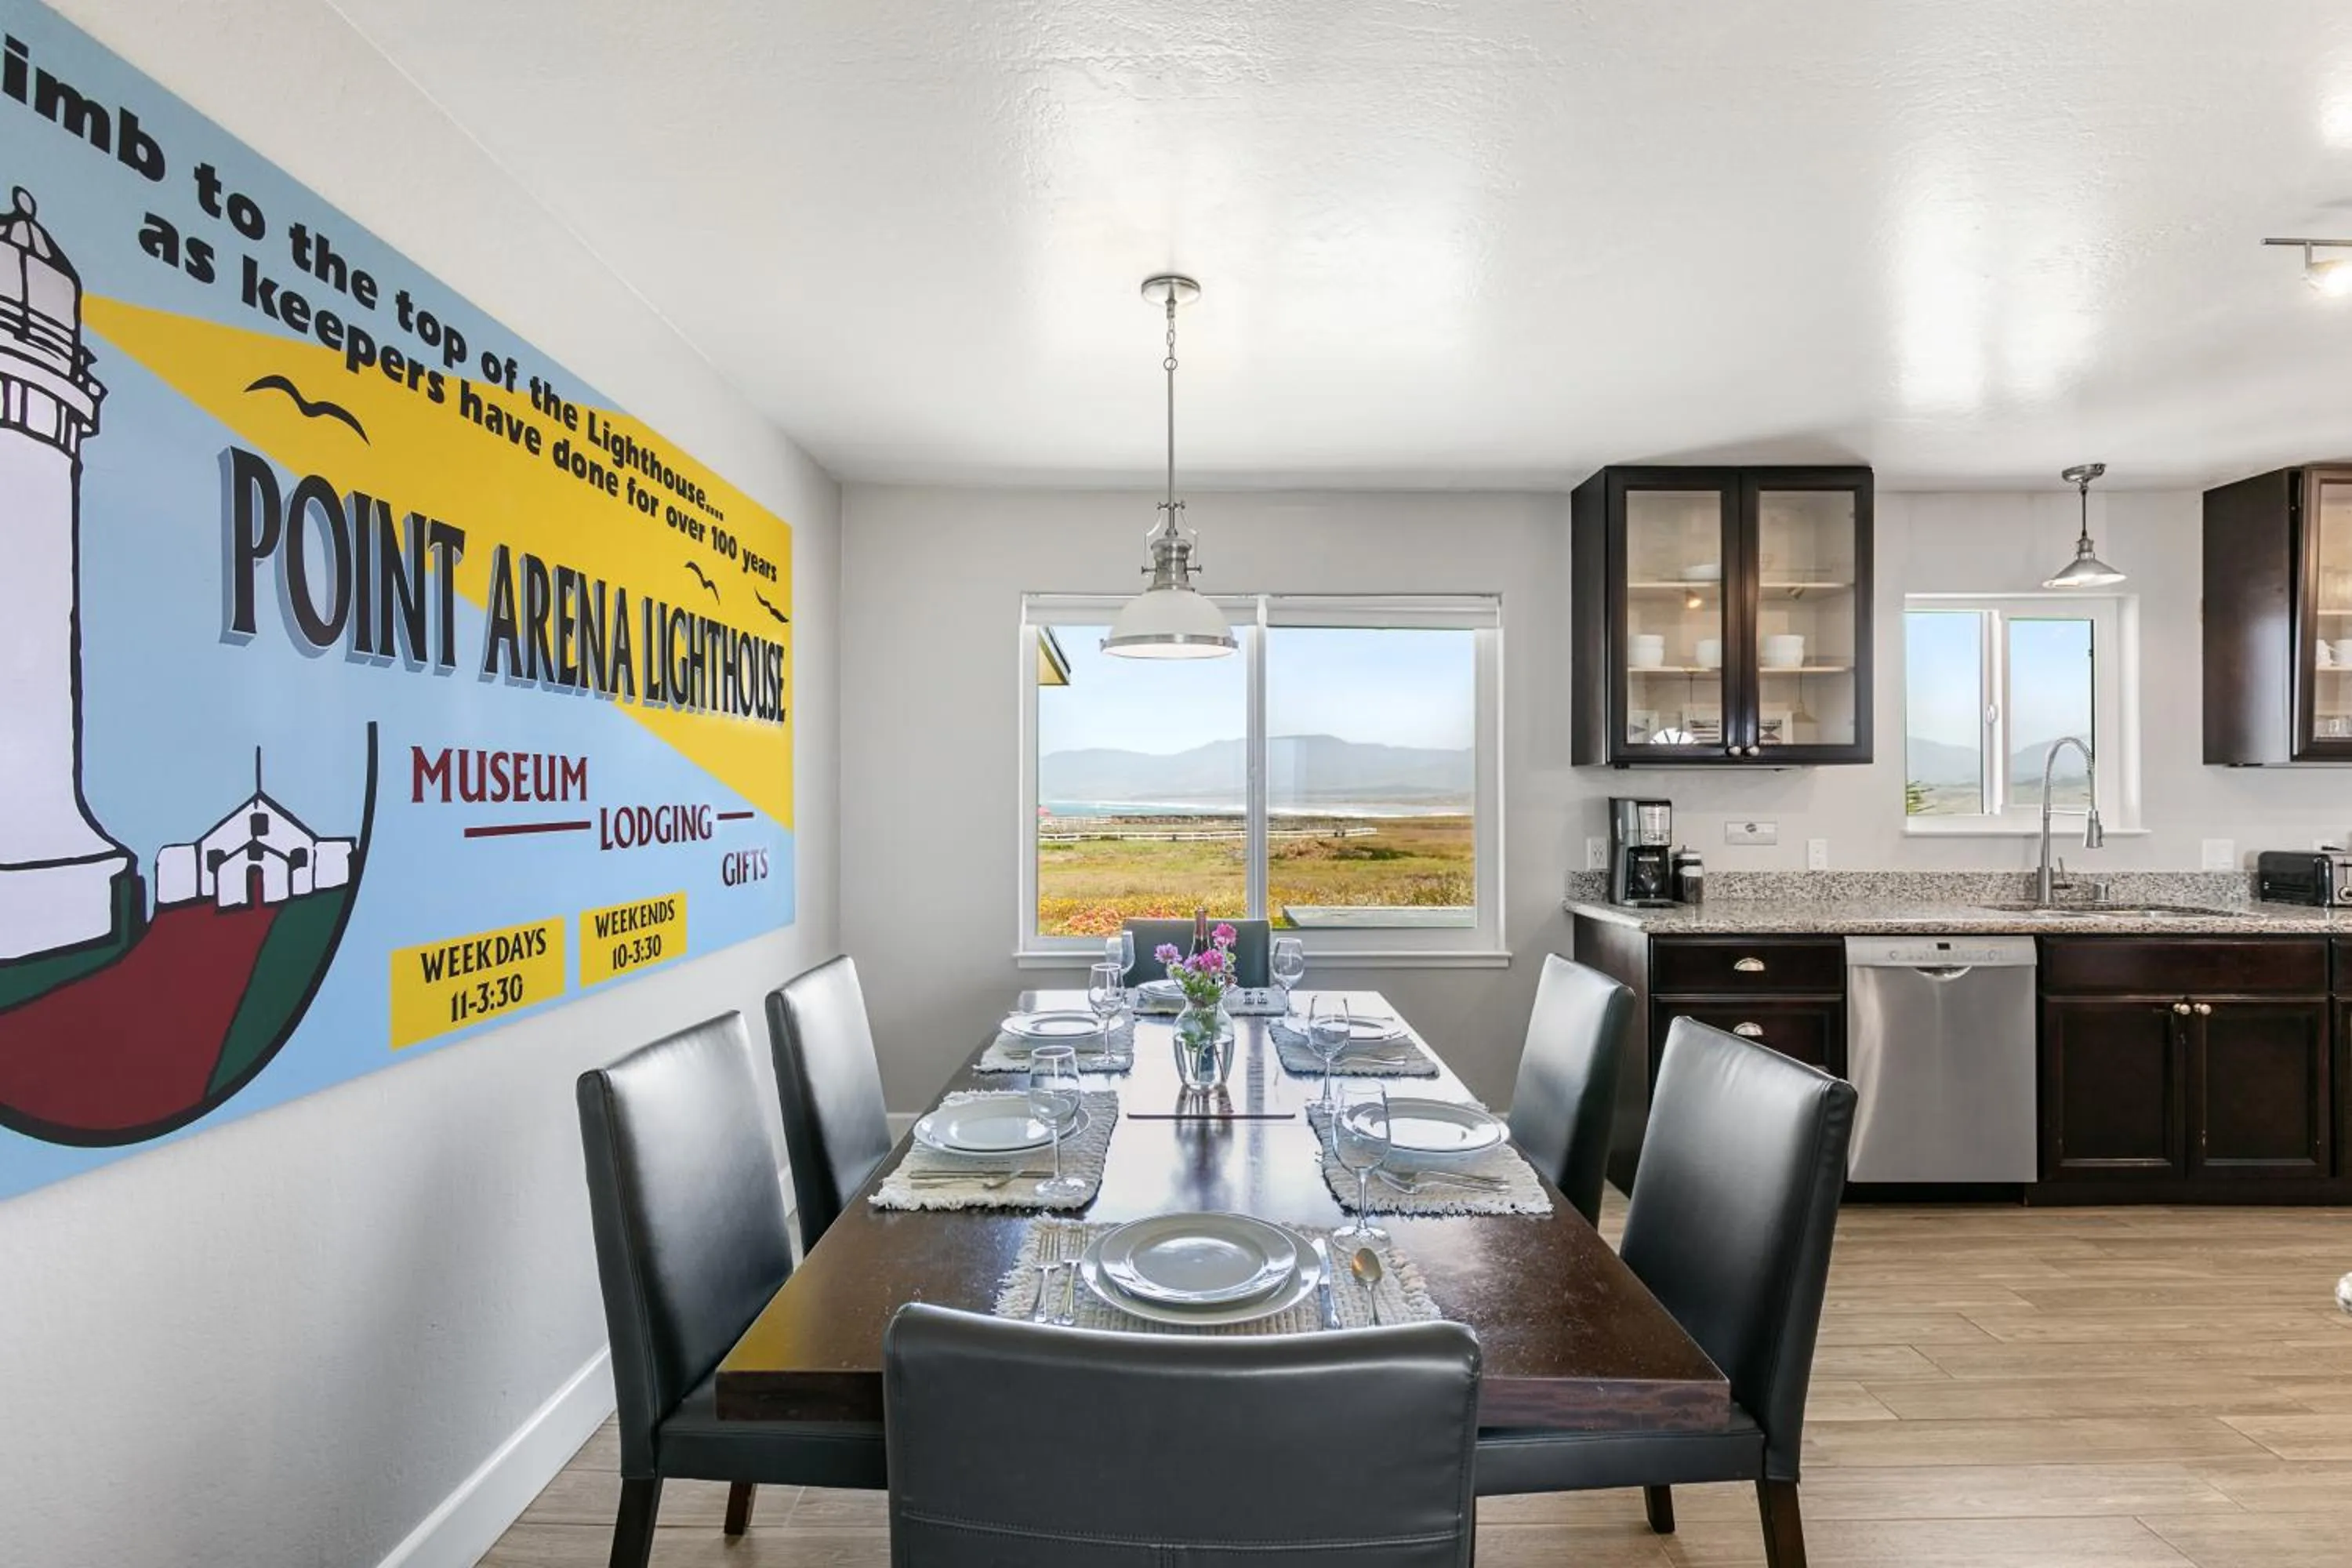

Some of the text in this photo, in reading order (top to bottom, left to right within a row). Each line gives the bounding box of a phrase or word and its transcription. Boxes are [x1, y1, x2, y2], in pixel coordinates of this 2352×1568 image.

[2, 33, 165, 182] imb
[194, 162, 266, 241] to
[289, 222, 378, 310] the
[396, 290, 466, 368] top
[481, 350, 517, 393] of
[530, 376, 577, 430] the
[138, 212, 777, 583] as keepers have done for over 100 years
[217, 445, 786, 726] POINT ARENA LIGHTHOUSE
[410, 746, 588, 804] MUSEUM
[600, 804, 713, 851] LODGING
[722, 848, 768, 887] GIFTS
[595, 899, 675, 938] WEEKENDS
[420, 927, 546, 984] WEEKDAYS
[612, 934, 662, 971] 10-3:30
[450, 974, 523, 1022] 11-3:30
